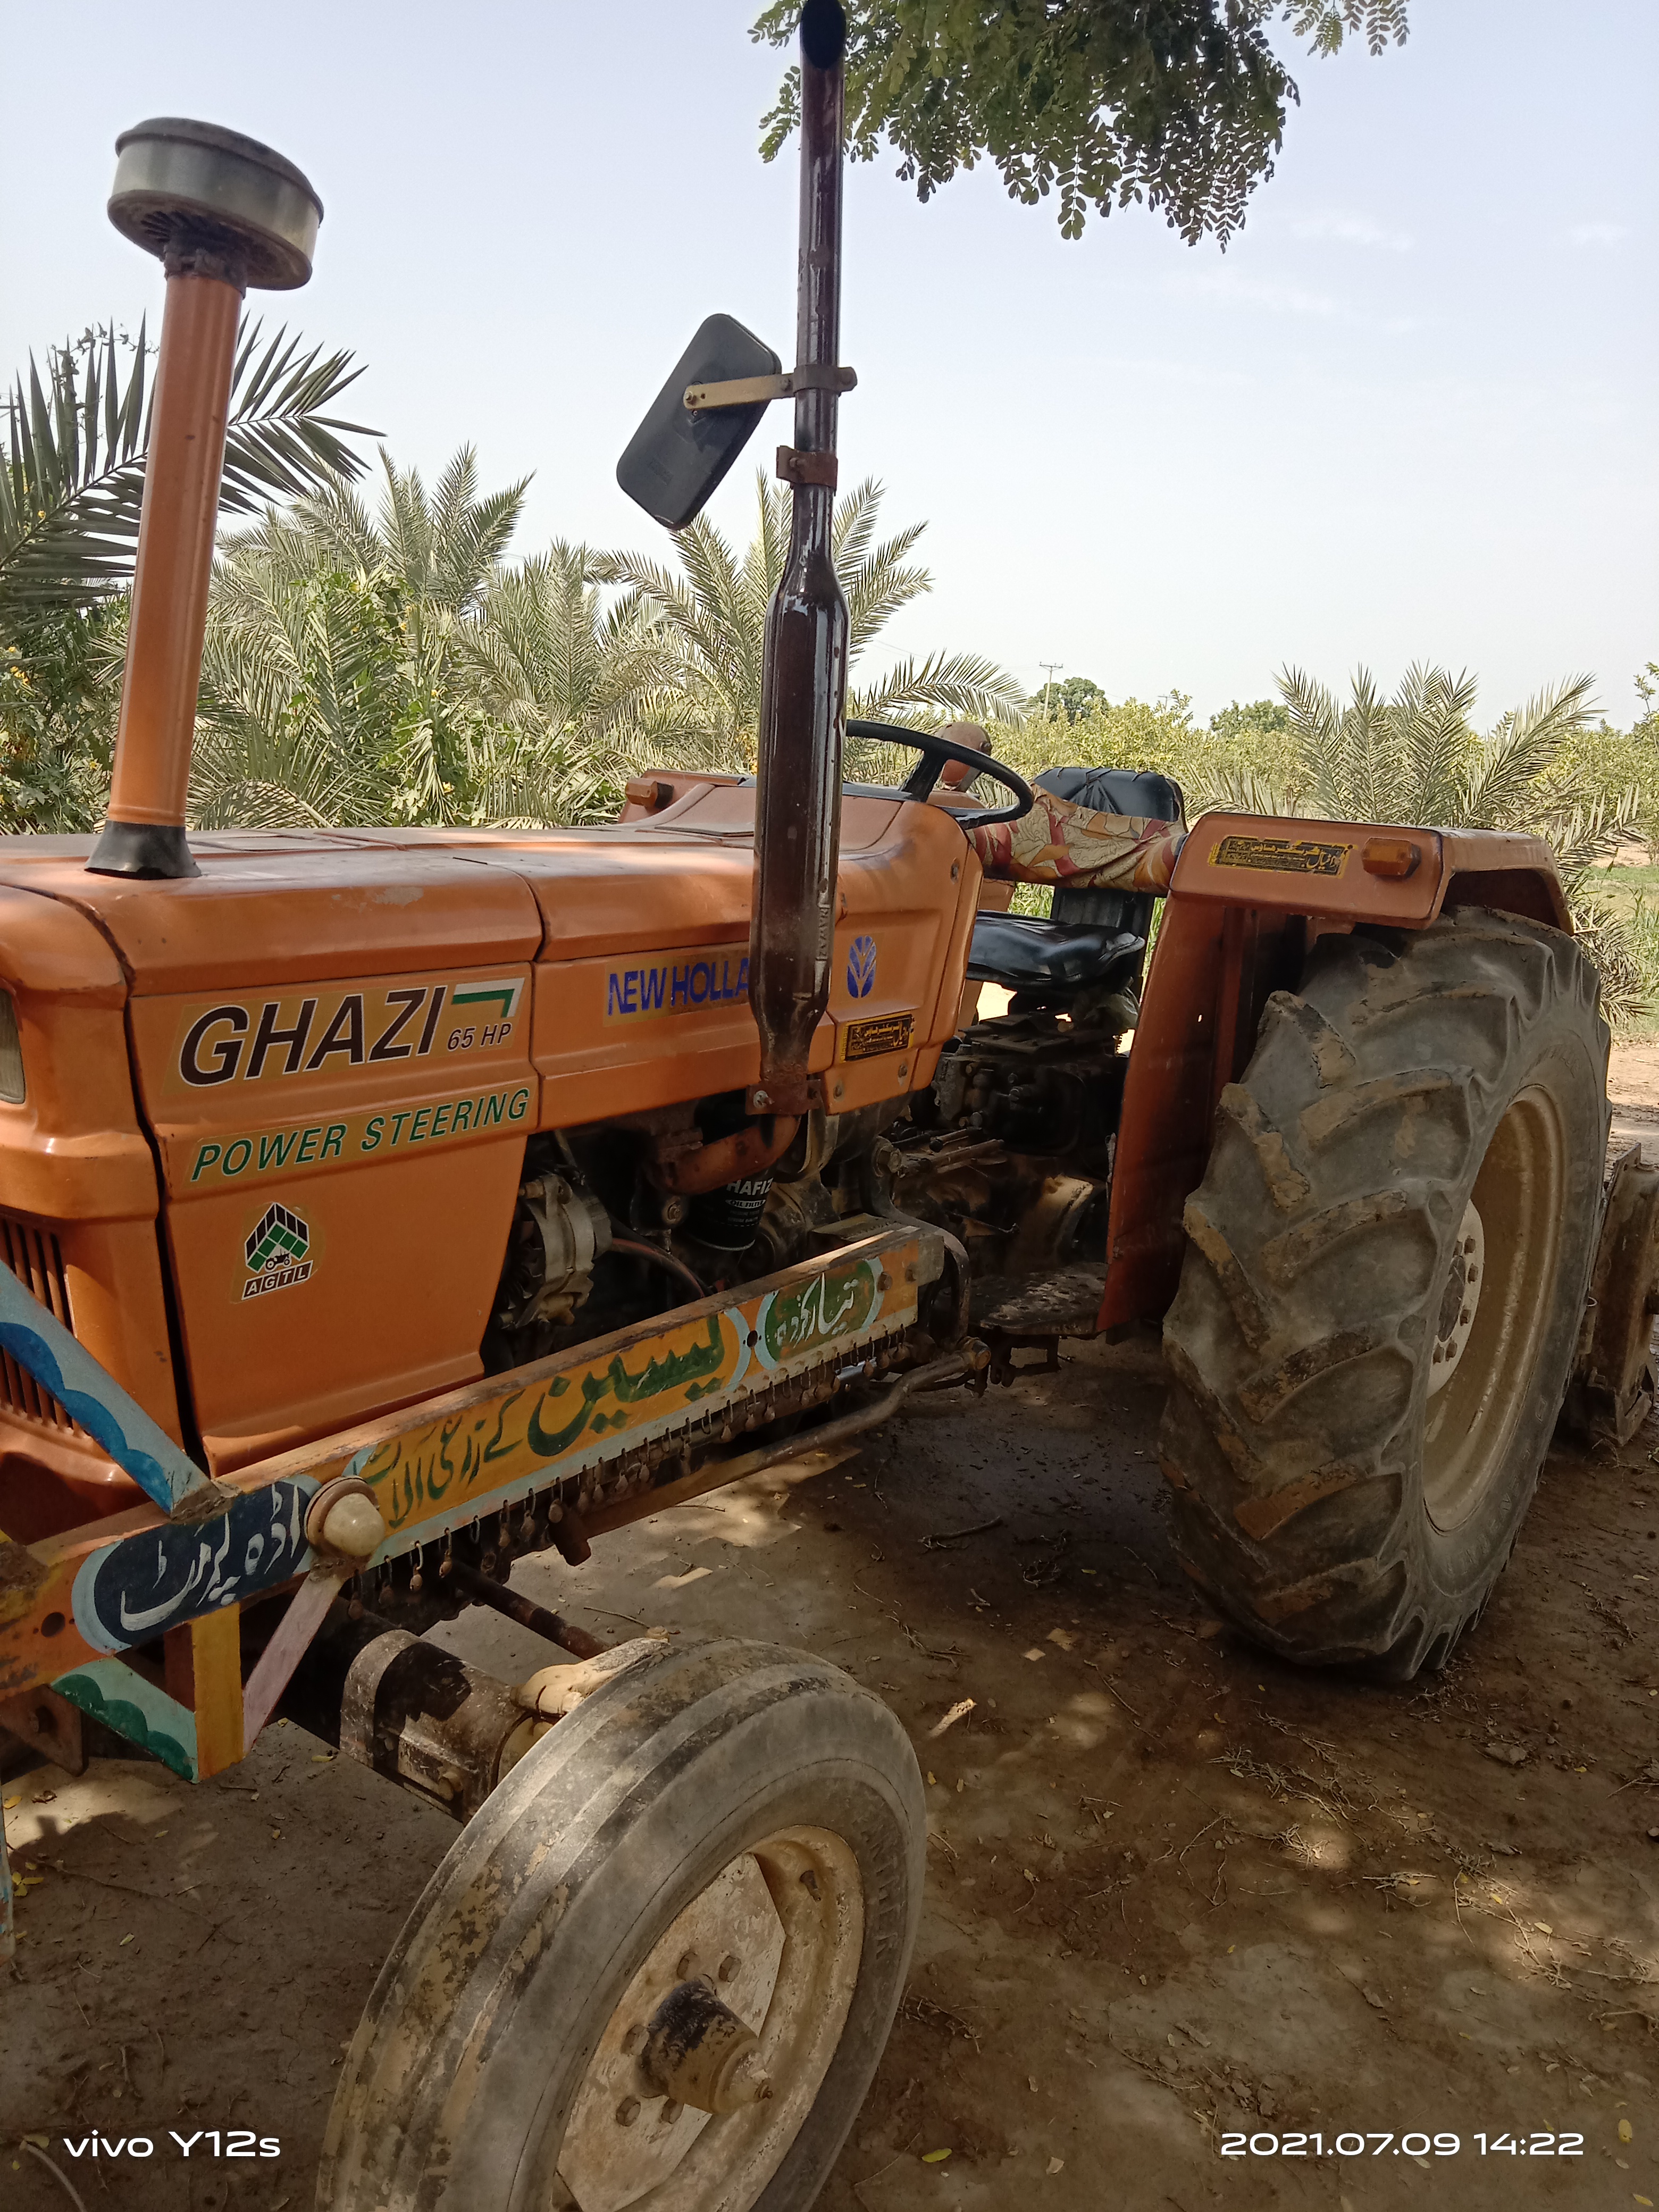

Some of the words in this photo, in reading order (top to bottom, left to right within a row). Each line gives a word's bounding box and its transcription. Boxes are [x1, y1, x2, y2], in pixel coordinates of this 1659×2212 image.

[608, 967, 667, 1016] NEW
[671, 957, 750, 1007] HOLLA
[178, 985, 448, 1087] GHAZI
[447, 1028, 475, 1052] 65
[481, 1022, 513, 1047] HP
[190, 1124, 347, 1182] POWER
[360, 1088, 531, 1152] STEERING
[726, 1177, 774, 1196] HAFIZ
[245, 1263, 311, 1297] AGTL
